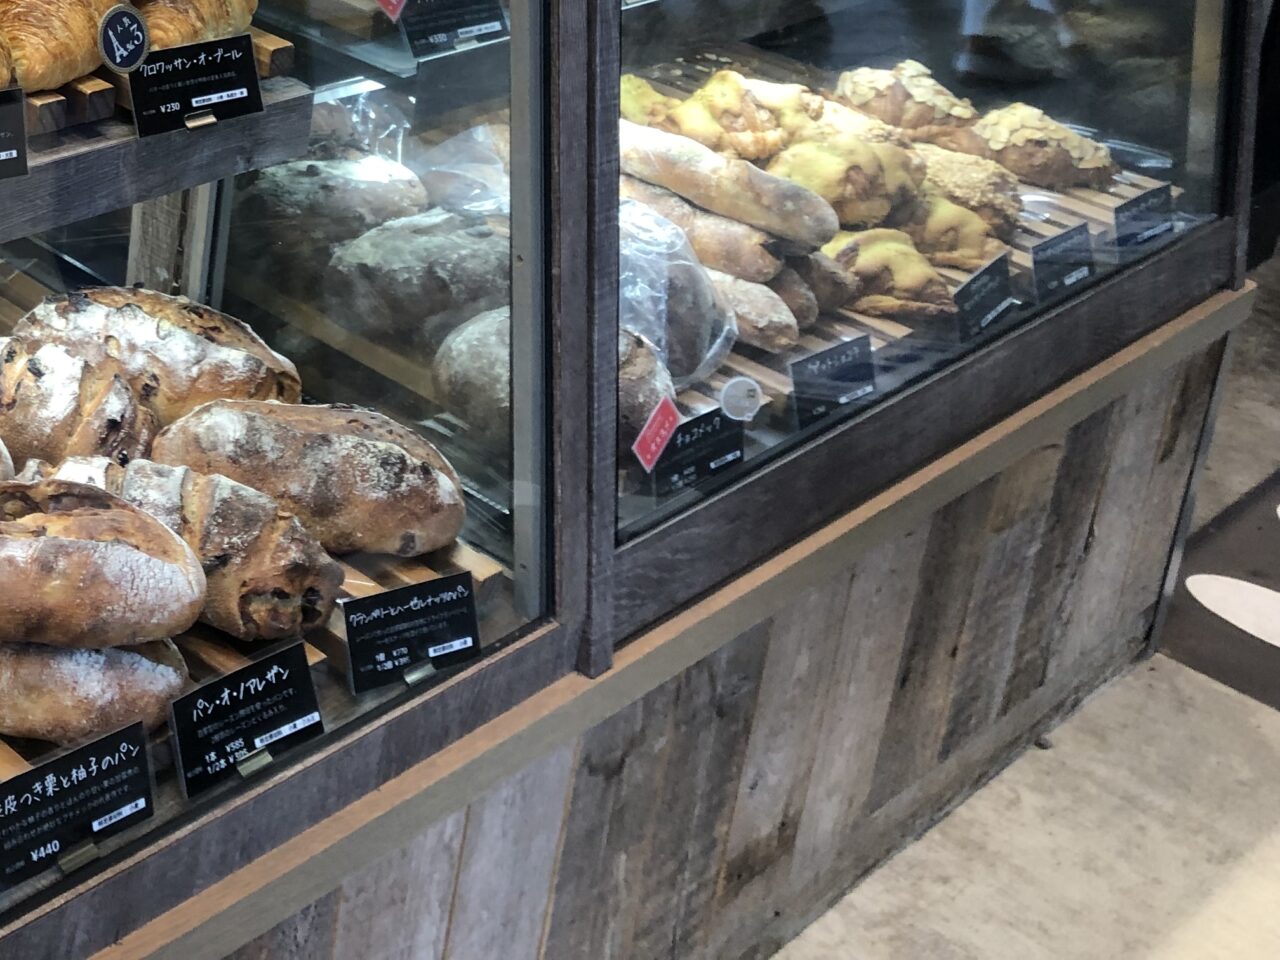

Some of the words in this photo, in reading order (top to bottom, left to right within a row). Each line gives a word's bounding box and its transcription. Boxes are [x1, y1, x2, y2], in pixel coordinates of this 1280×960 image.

[139, 48, 243, 78] クロワッサン・オ・ブール
[160, 102, 181, 114] ¥230
[29, 839, 61, 863] ¥440
